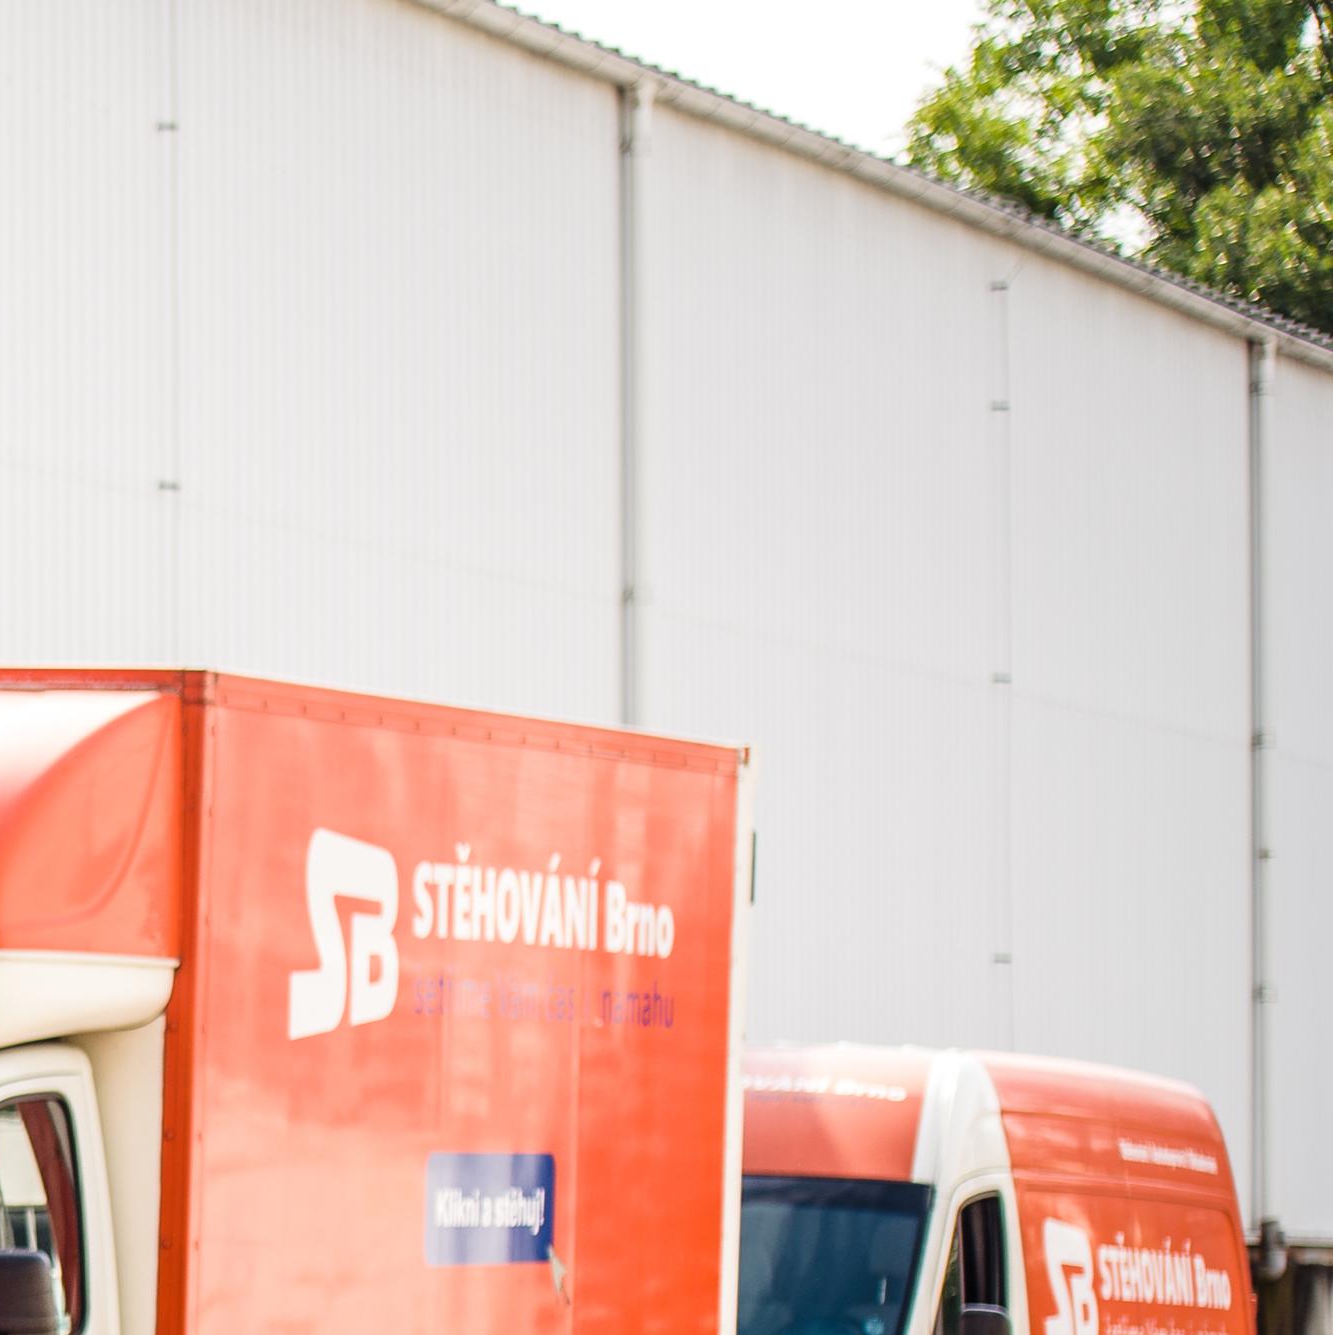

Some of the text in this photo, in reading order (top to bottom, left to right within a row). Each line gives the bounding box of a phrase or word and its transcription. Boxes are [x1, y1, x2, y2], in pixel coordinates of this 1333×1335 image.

[289, 827, 399, 1041] SB
[412, 842, 675, 959] STĚHOVÁNÍ Brno
